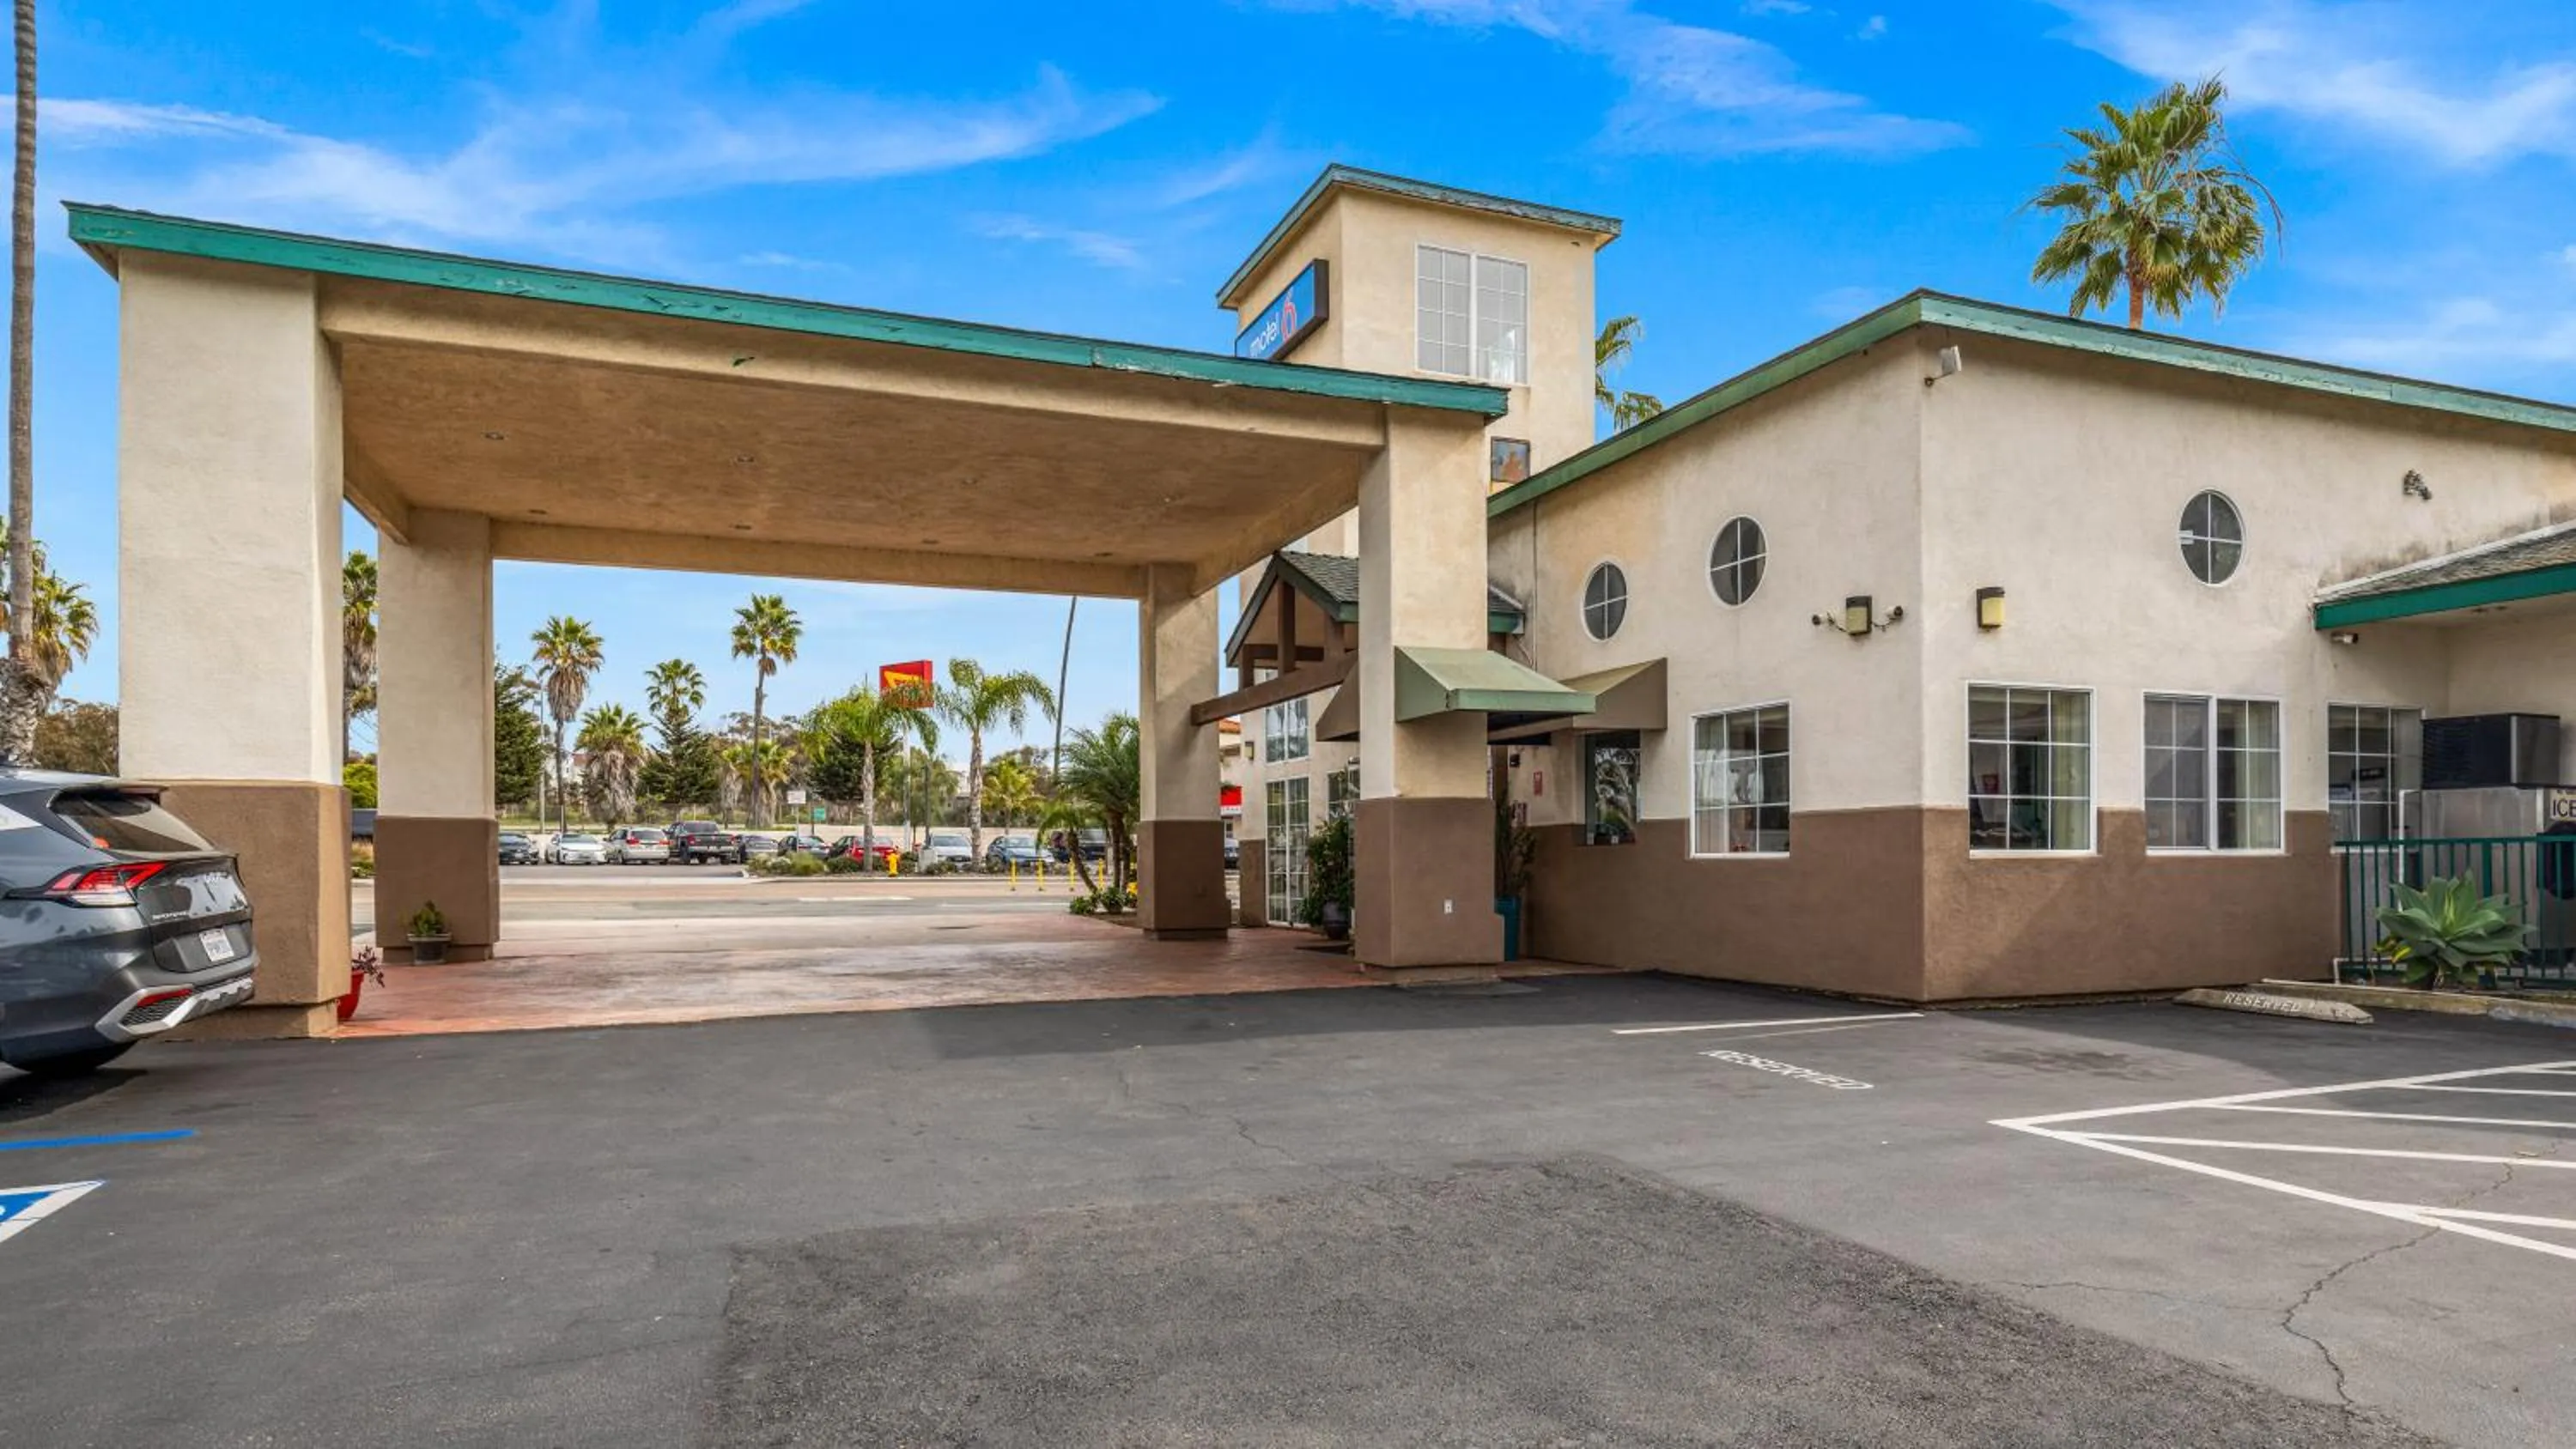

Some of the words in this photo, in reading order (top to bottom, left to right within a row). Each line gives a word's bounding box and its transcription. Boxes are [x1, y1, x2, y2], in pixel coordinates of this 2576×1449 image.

[1250, 312, 1280, 358] motel
[2553, 797, 2576, 817] ICE
[2222, 991, 2303, 1012] RESERVED
[1698, 1050, 1874, 1089] RESERVED
